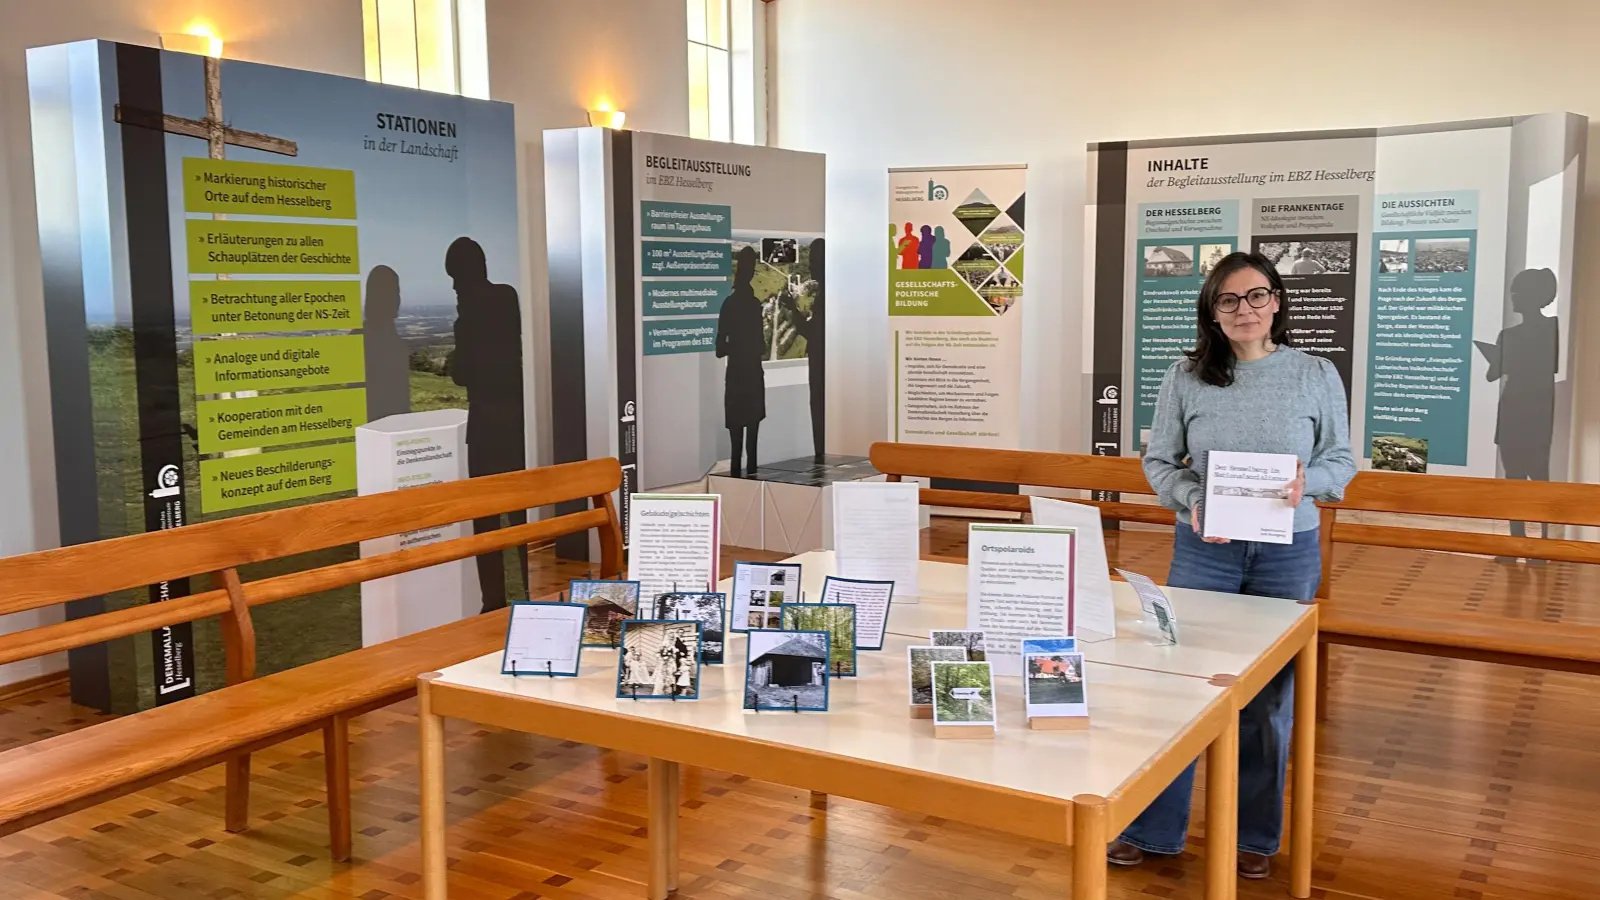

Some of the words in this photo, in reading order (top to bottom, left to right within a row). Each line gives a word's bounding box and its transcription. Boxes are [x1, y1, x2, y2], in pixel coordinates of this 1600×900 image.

[376, 113, 456, 138] STATIONEN
[364, 135, 375, 149] in
[378, 137, 396, 152] der
[400, 140, 458, 162] Landschaft
[646, 155, 751, 176] BEGLEITAUSSTELLUNG
[1148, 158, 1208, 172] INHALTE
[204, 172, 266, 189] Markierung
[268, 176, 326, 190] historischer
[646, 175, 656, 185] im
[658, 174, 674, 186] EBZ
[676, 176, 714, 191] Hesselberg
[1147, 176, 1164, 188] der
[1167, 172, 1266, 189] Begleitausstellung
[1269, 172, 1284, 183] im
[1288, 170, 1312, 181] EBZ
[1314, 168, 1375, 182] Hesselberg
[205, 191, 229, 202] Orte
[232, 192, 249, 202] auf
[252, 193, 274, 204] dem
[277, 194, 331, 210] Hesselberg
[1278, 203, 1344, 212] FRANKENTAGE
[1398, 199, 1455, 208] AUSSICHTEN
[651, 209, 688, 219] Barrierefreier
[690, 210, 725, 222] Ausstellungs-
[1165, 207, 1221, 216] HESSELBERG
[676, 222, 711, 233] Tagungshaus
[208, 233, 284, 248] Erläuterungen
[286, 237, 297, 246] zu
[300, 236, 323, 246] allen
[208, 251, 279, 265] Schauplätzen
[282, 252, 298, 262] der
[300, 253, 351, 264] Geschichte
[672, 250, 723, 260] Ausstellungsfläche
[666, 261, 719, 271] Außenpräsentation
[211, 294, 276, 306] Betrachtung
[280, 293, 301, 303] aller
[304, 293, 345, 305] Epochen
[653, 289, 680, 297] Modernes
[681, 289, 717, 297] multimediales
[653, 300, 707, 310] Ausstellungskonzept
[212, 312, 241, 322] unter
[244, 310, 294, 322] Betonung
[297, 310, 312, 320] der
[316, 309, 350, 319] NS-Zeit
[653, 327, 713, 337] Vermittlungsangebote
[662, 339, 690, 348] Programm
[692, 338, 701, 347] des
[214, 352, 257, 364] Analoge
[260, 350, 280, 361] und
[282, 349, 320, 361] digitale
[215, 365, 329, 381] Informationsangebote
[217, 408, 283, 424] Kooperation
[285, 405, 302, 416] mit
[305, 404, 322, 414] den
[218, 425, 279, 440] Gemeinden
[282, 423, 297, 433] am
[300, 418, 352, 431] Hesselberg
[220, 469, 254, 481] Neues
[256, 458, 335, 476] Beschilderungs-
[1230, 465, 1268, 474] Hesselberg
[221, 484, 263, 499] konzept
[266, 480, 282, 492] auf
[285, 478, 307, 489] dem
[309, 474, 331, 485] Berg
[981, 544, 1035, 553] Ortspolaroids
